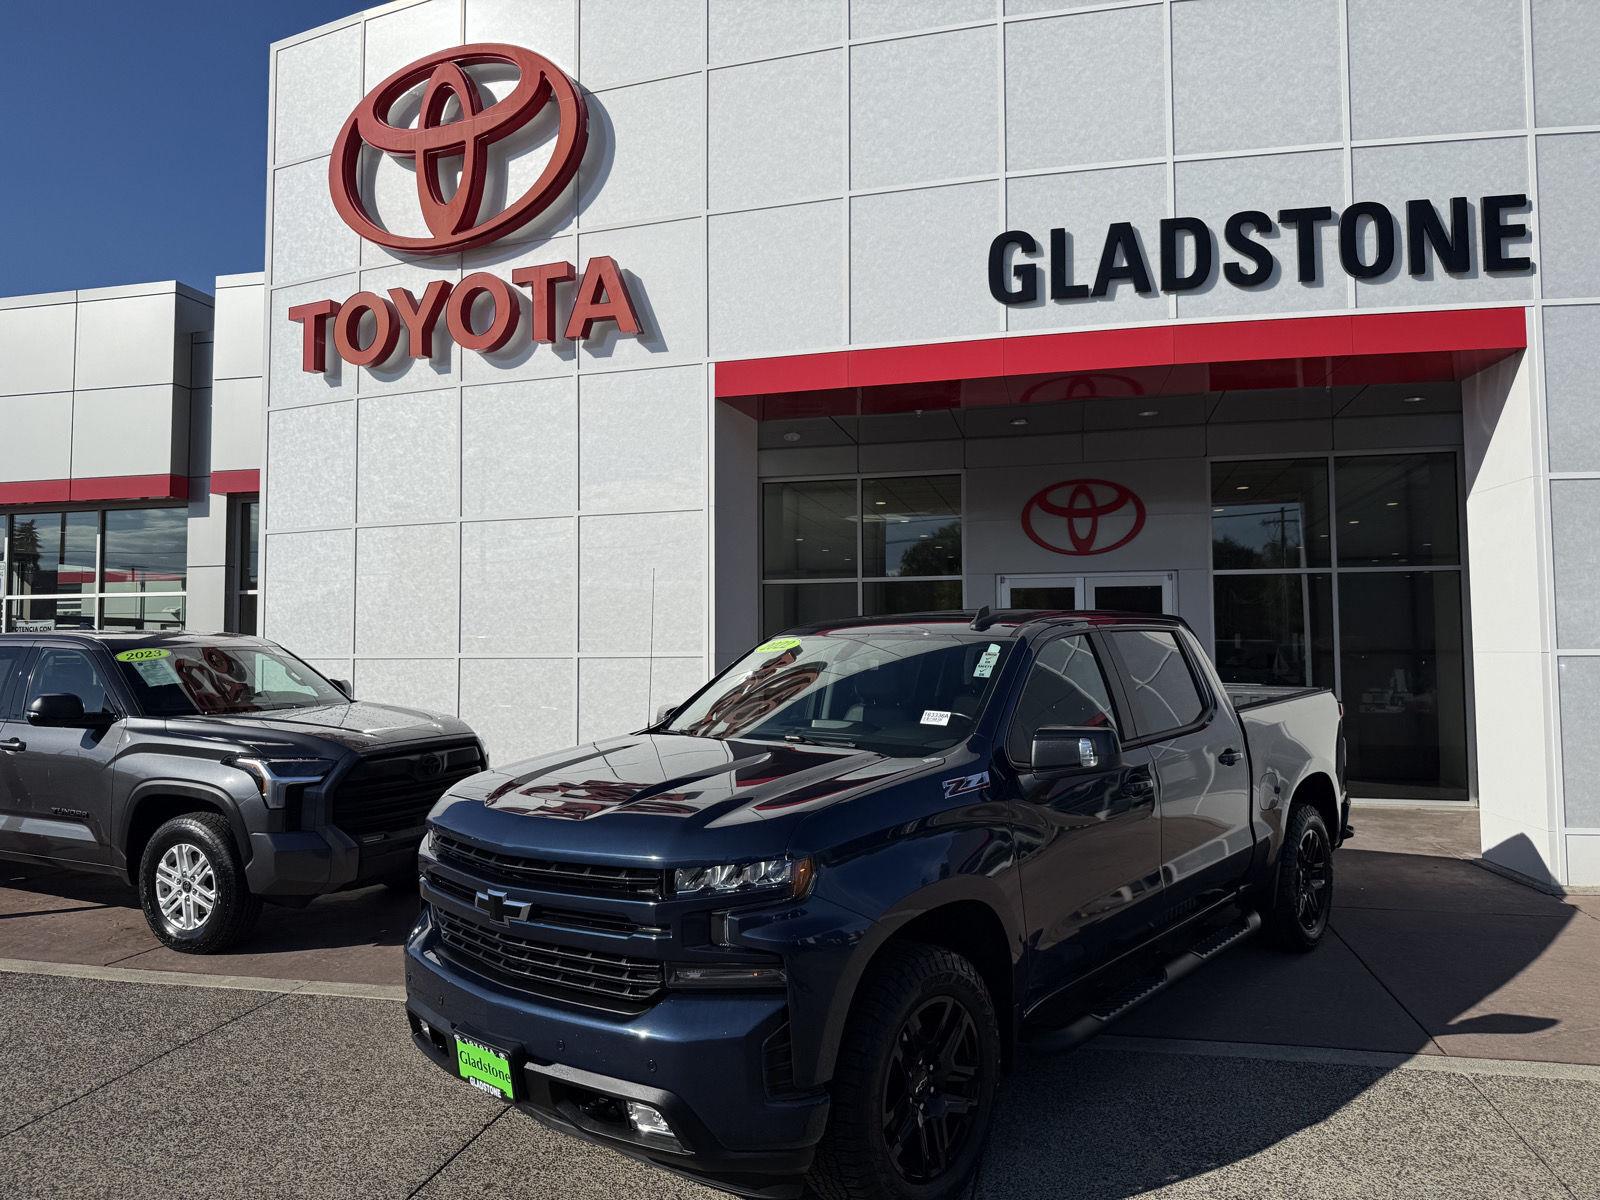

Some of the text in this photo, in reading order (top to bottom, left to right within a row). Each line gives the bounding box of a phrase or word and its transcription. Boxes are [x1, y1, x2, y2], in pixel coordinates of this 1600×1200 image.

[988, 193, 1532, 304] GLADSTONE
[288, 255, 645, 373] TOYOTA
[126, 650, 162, 660] 2023
[459, 1050, 511, 1084] Gladstone
